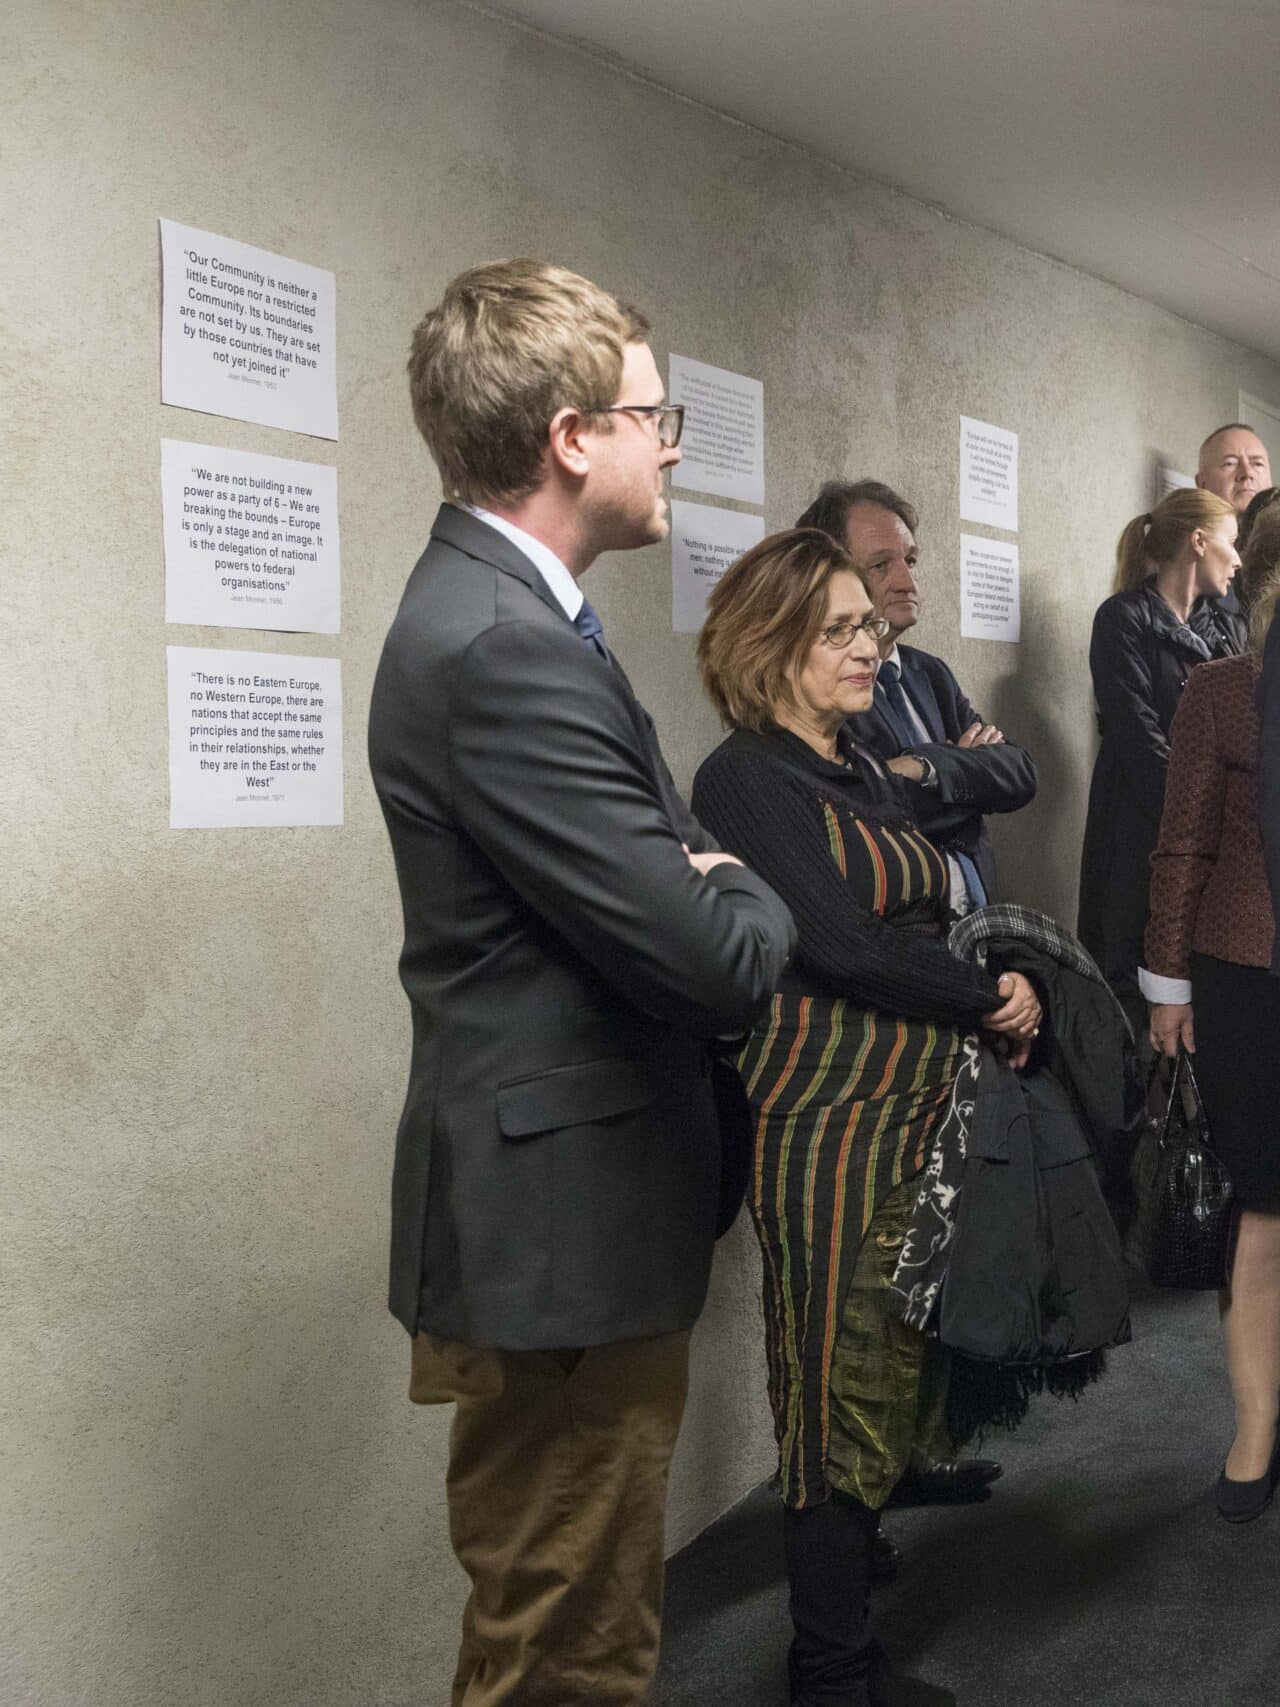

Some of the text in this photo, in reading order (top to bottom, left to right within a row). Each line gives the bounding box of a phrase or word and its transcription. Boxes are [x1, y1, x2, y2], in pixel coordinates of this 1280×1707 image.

[211, 257, 265, 287] Community
[268, 275, 276, 288] is
[278, 281, 310, 298] neither
[312, 291, 318, 301] a
[187, 267, 316, 318] little Europe nor a restricted
[180, 305, 197, 318] are
[199, 311, 216, 324] not
[218, 316, 234, 329] set
[236, 318, 248, 335] by
[266, 327, 289, 347] They
[290, 336, 305, 349] are
[306, 341, 321, 353] set
[250, 304, 262, 319] Its
[263, 308, 314, 334] boundaries
[184, 322, 317, 369] by those countries that have
[213, 351, 230, 364] not
[232, 355, 247, 368] yet
[248, 357, 277, 376] joined
[215, 473, 230, 484] are
[232, 476, 248, 487] not
[249, 476, 285, 495] building
[287, 484, 293, 494] a
[295, 485, 313, 497] new
[184, 486, 215, 499] power
[217, 490, 228, 501] as
[230, 492, 236, 502] a
[238, 493, 261, 508] party
[263, 495, 273, 507] of
[274, 497, 280, 509] 6
[289, 498, 304, 512] We
[306, 503, 320, 514] are
[184, 501, 226, 521] breaking
[228, 507, 243, 520] the
[245, 508, 279, 525] bounds
[289, 515, 321, 532] Europe
[182, 518, 191, 531] is
[193, 520, 214, 536] only
[216, 524, 223, 535] a
[225, 525, 250, 540] stage
[252, 528, 270, 541] and
[272, 532, 283, 543] an
[317, 535, 324, 547] It
[190, 536, 317, 562] is the delegation of national
[215, 559, 296, 576] powers to federal
[227, 673, 236, 686] is
[238, 677, 251, 687] no
[253, 675, 288, 688] Eastern
[191, 691, 204, 701] no
[206, 689, 246, 703] Western
[286, 694, 308, 707] there
[310, 697, 324, 707] are
[192, 707, 322, 724] nations that accept the same
[190, 724, 324, 740] principles and the same rules
[190, 740, 199, 752] in
[201, 741, 224, 753] their
[291, 743, 325, 755] whether
[200, 759, 317, 773] they are in the East or the
